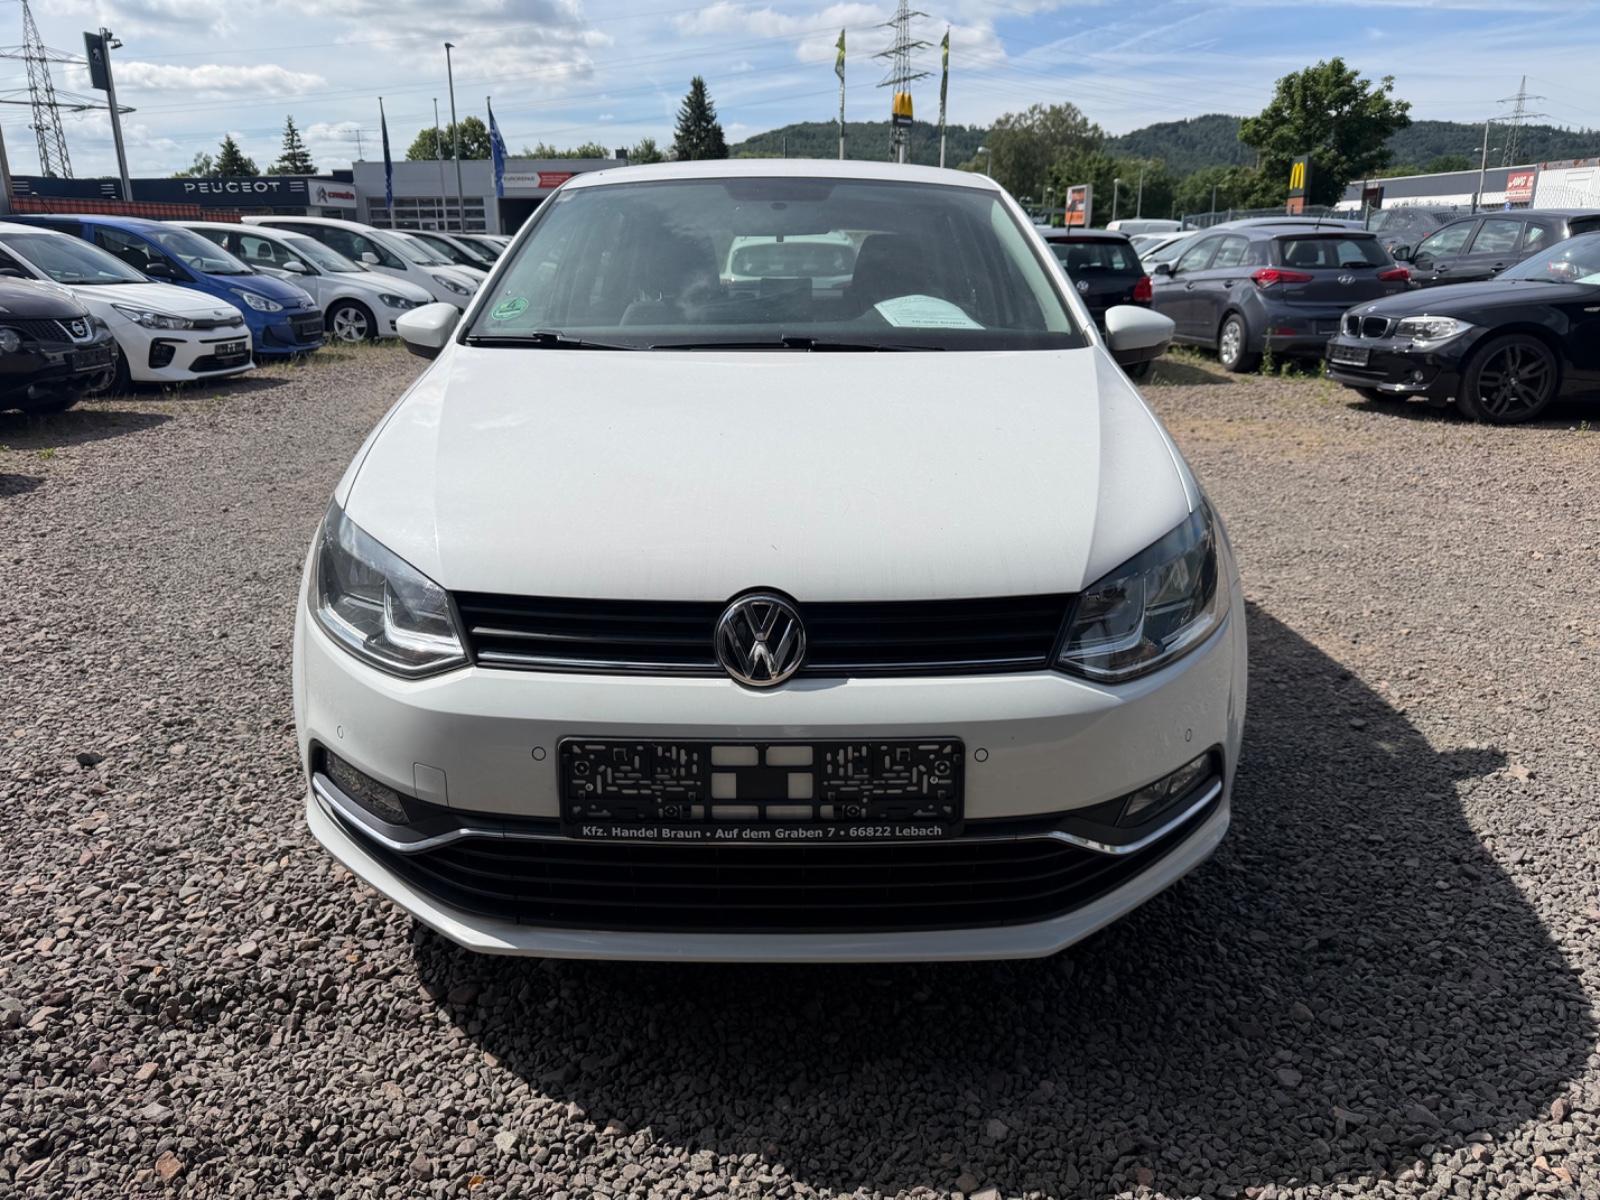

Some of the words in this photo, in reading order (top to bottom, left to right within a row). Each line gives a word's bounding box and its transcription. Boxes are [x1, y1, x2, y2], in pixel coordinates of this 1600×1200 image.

[184, 181, 280, 194] PEUGEOT
[582, 826, 607, 837] Kfz.
[612, 827, 658, 838] Handel
[661, 828, 701, 840] Braun
[715, 828, 739, 840] Auf
[742, 828, 771, 840] dem
[774, 828, 823, 840] Graben
[827, 828, 835, 838] 7
[849, 827, 891, 838] 66822
[895, 826, 942, 837] Lebach
